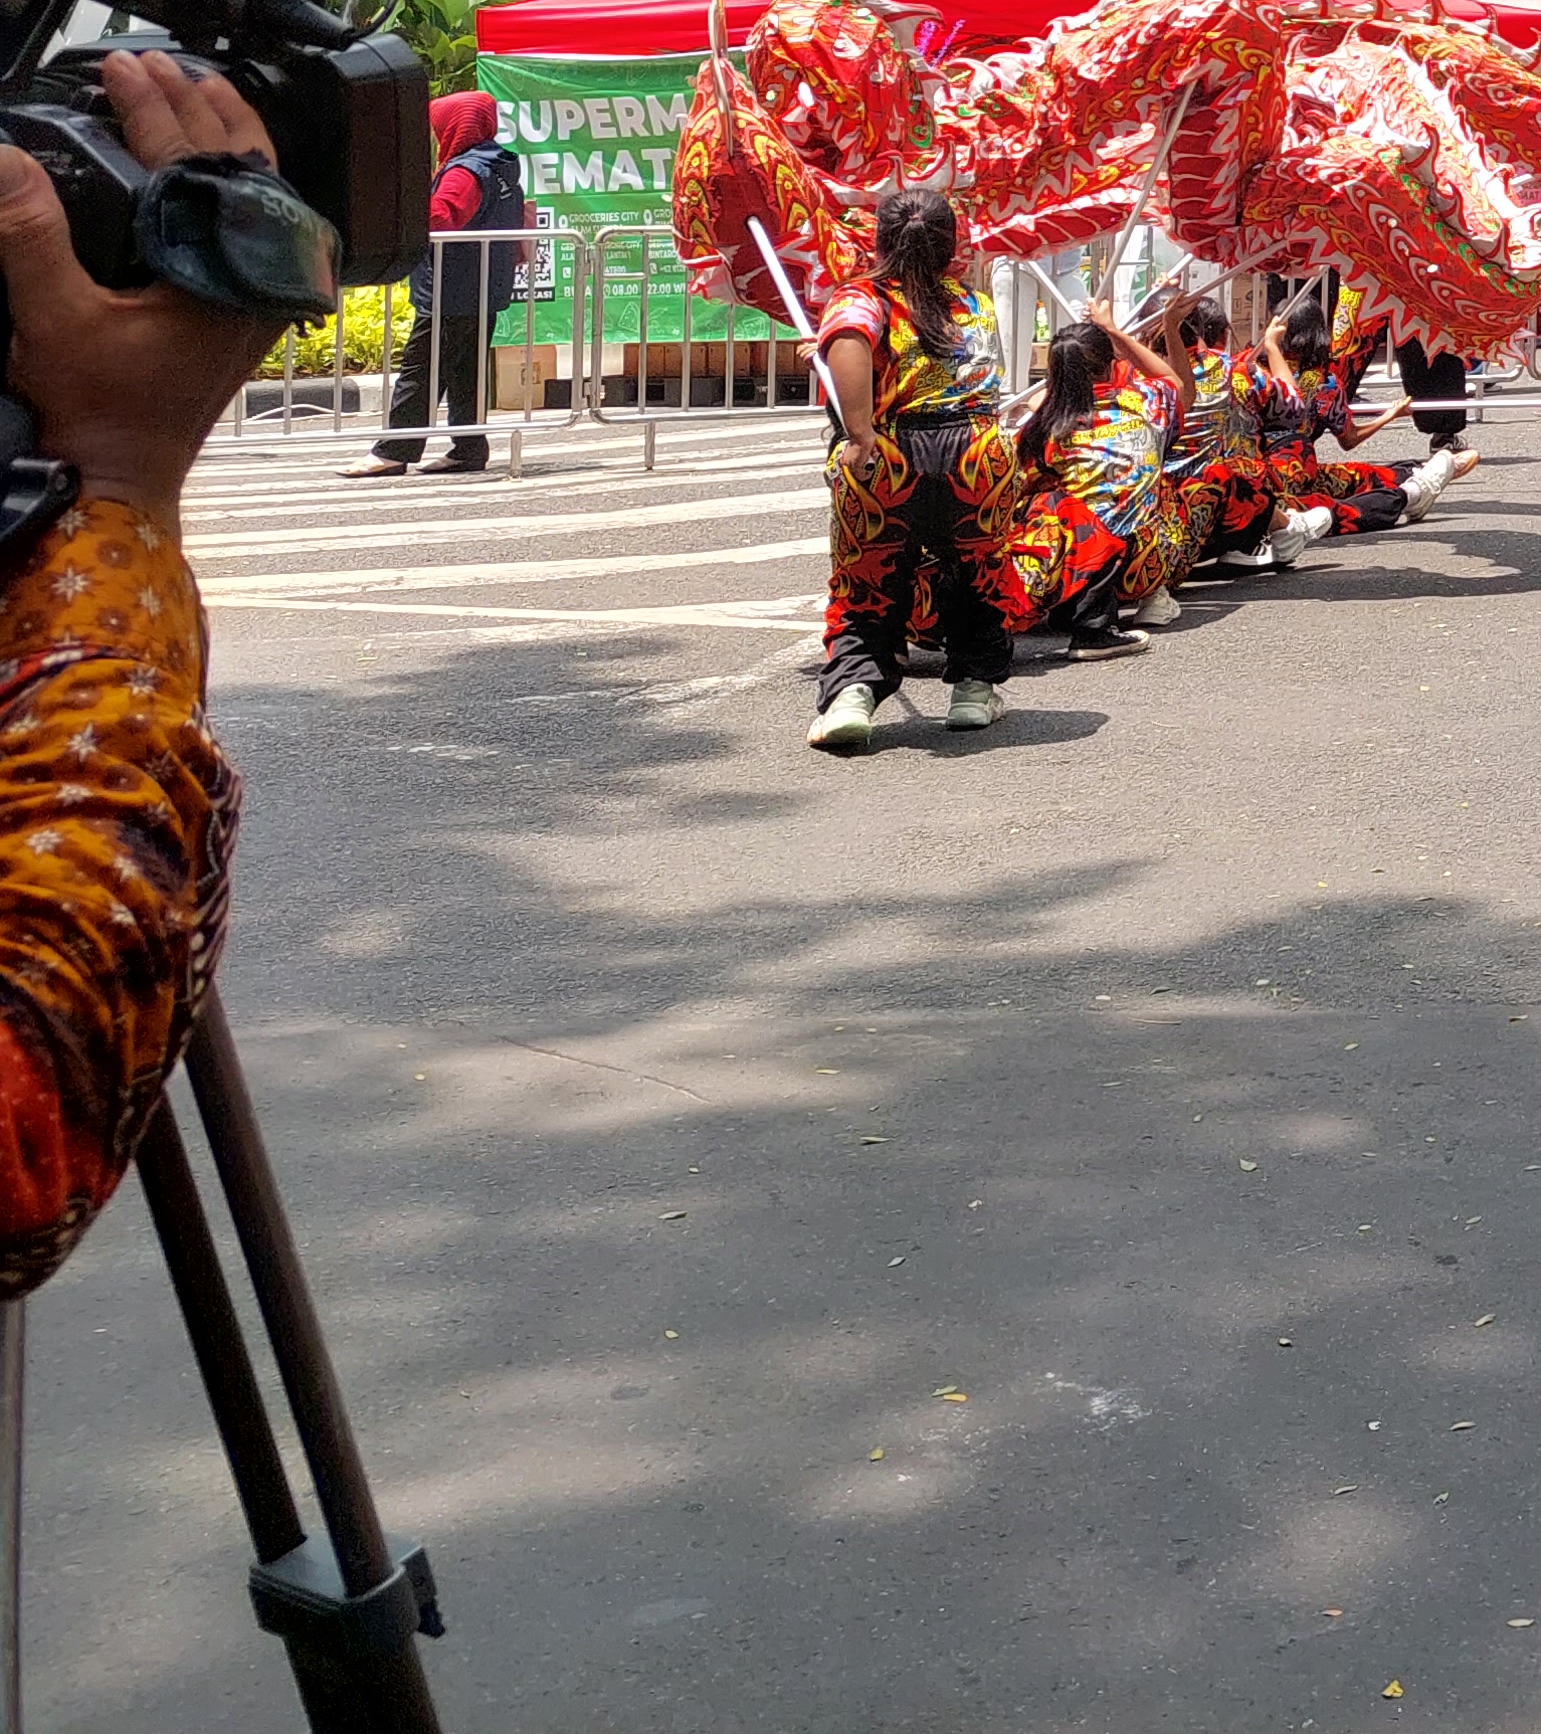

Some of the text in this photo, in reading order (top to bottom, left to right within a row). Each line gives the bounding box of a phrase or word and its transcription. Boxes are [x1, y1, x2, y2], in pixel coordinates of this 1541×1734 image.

[495, 93, 689, 144] SUPERM
[621, 211, 640, 222] CITY
[612, 284, 638, 295] 08.00
